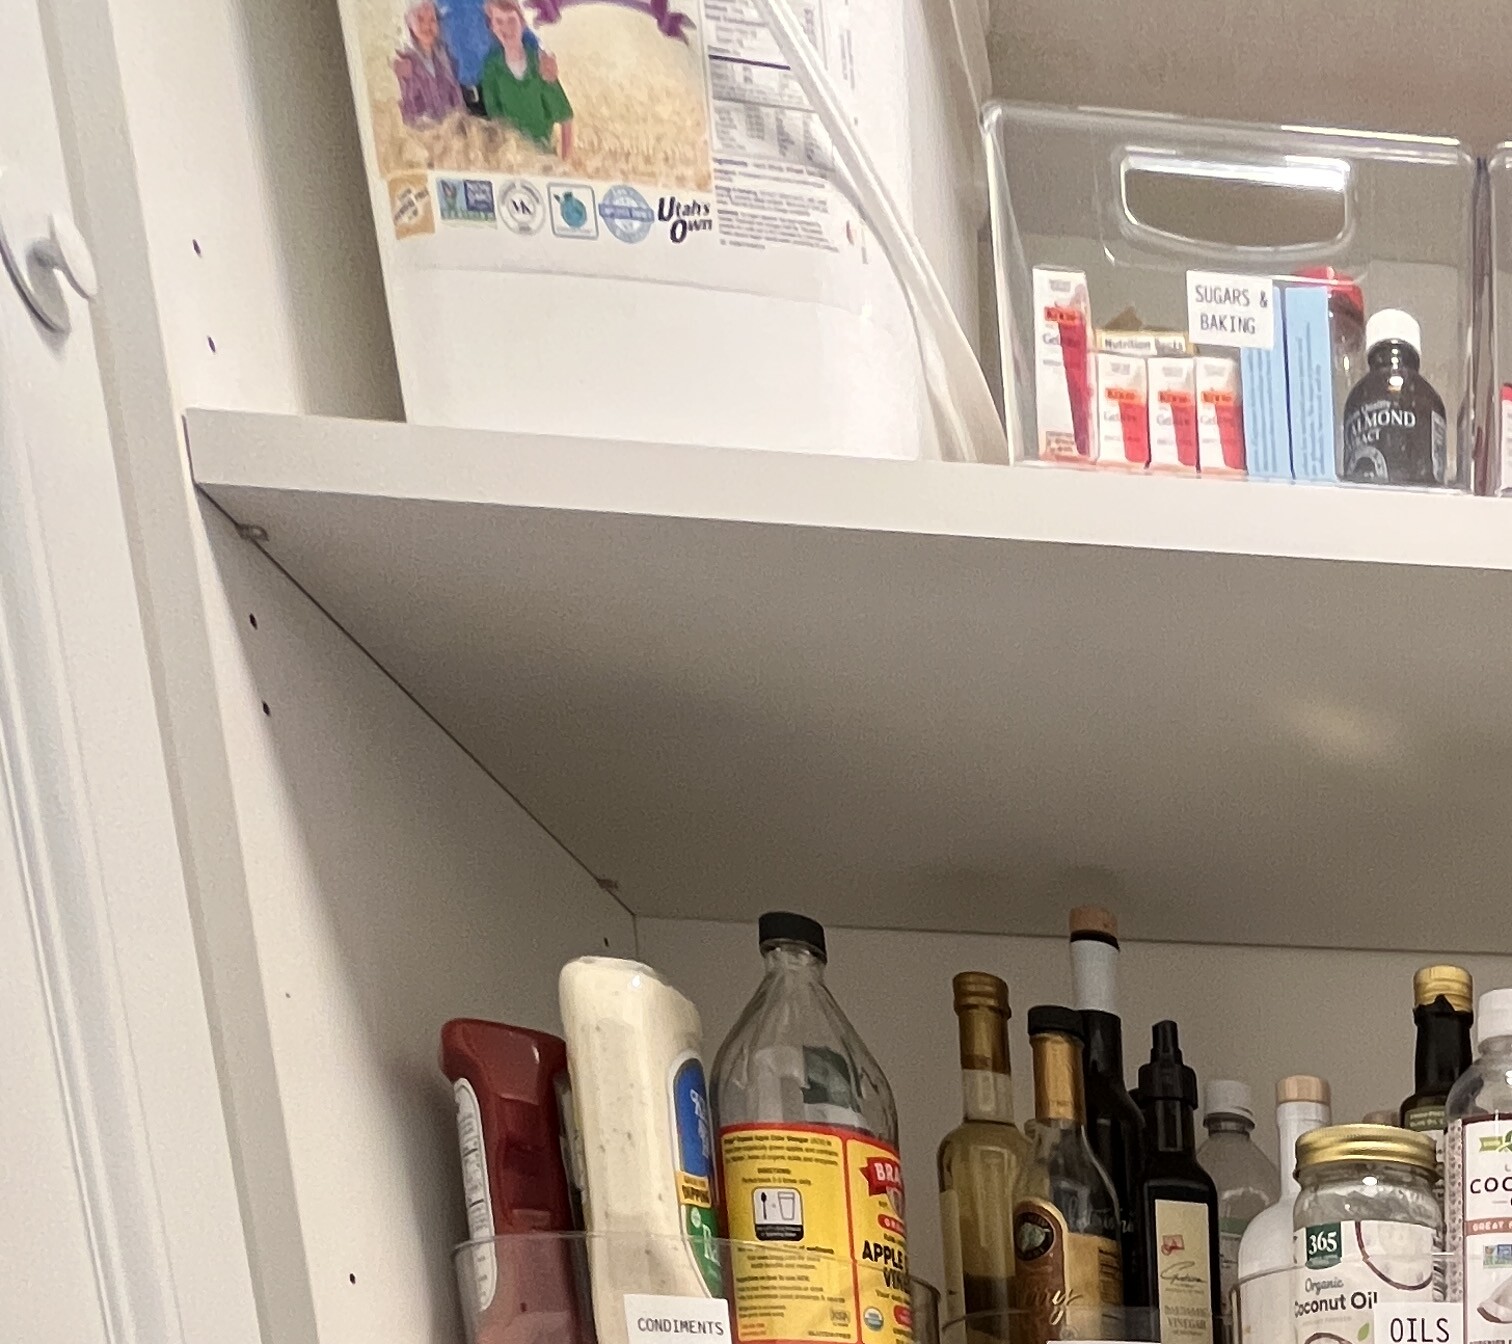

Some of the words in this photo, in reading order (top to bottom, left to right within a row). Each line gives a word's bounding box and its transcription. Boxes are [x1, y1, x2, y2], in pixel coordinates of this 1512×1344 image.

[1195, 284, 1250, 307] SUGARS
[1260, 291, 1269, 308] &
[1201, 313, 1256, 334] BAKING
[1472, 1220, 1504, 1232] GREAT
[1308, 1230, 1338, 1256] 365
[1304, 1277, 1344, 1296] Organic
[637, 1318, 724, 1337] CONDIMENTS
[1390, 1317, 1450, 1343] OILS
